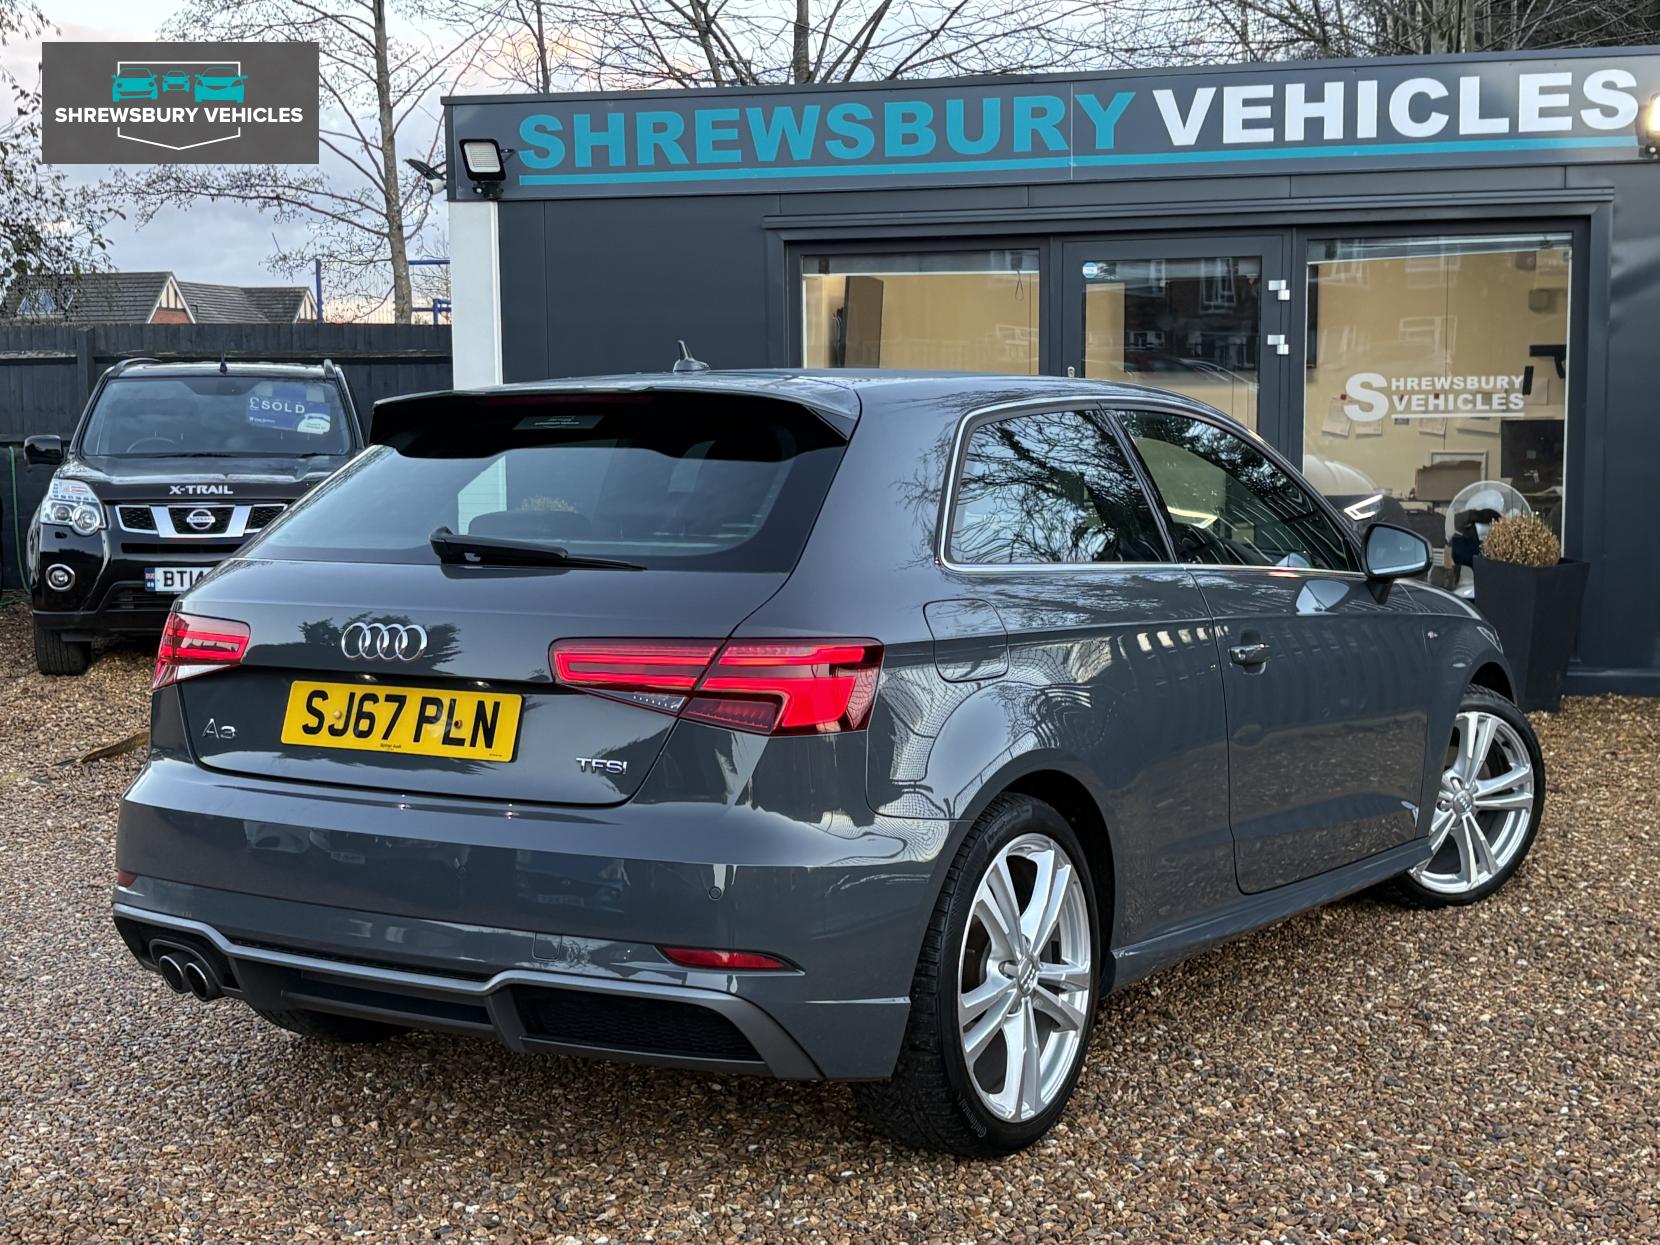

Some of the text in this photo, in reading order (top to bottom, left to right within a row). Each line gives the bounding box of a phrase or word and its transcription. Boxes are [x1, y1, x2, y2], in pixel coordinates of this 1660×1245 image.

[518, 68, 1639, 169] SHREWSBURY VEHICLES
[1392, 393, 1525, 411] VEHICLES
[169, 485, 233, 495] X-TRAIL
[202, 718, 235, 739] A3
[302, 690, 501, 749] SJ67 PLN
[576, 757, 628, 775] TFSI
